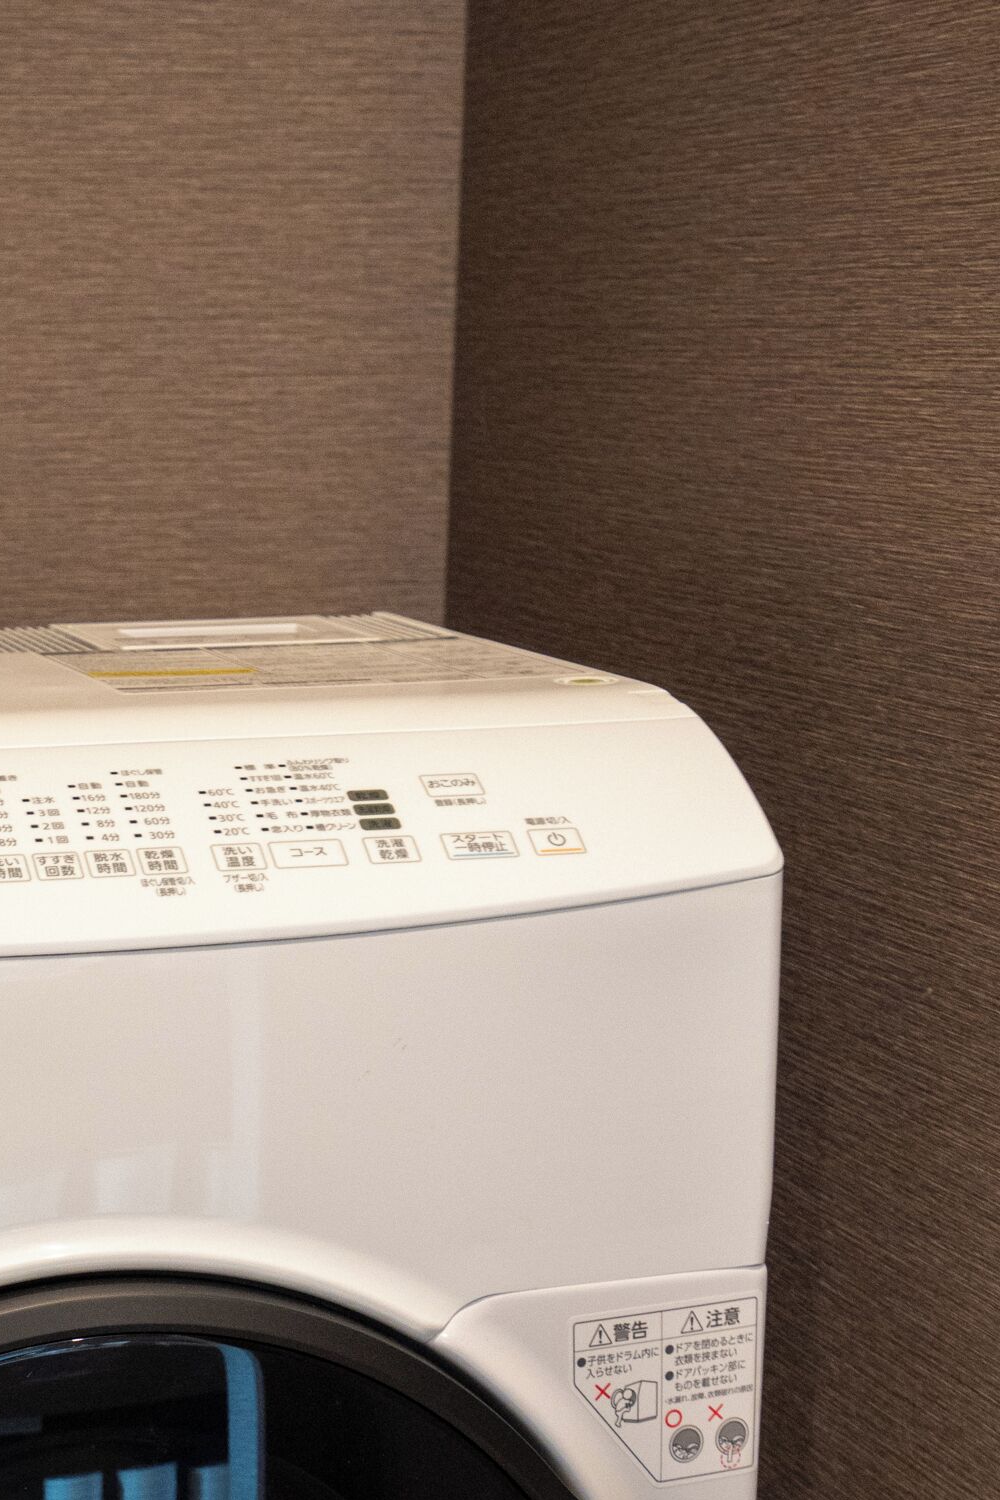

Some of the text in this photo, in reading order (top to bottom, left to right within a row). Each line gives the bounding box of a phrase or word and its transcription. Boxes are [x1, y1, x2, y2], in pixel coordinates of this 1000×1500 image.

[78, 782, 102, 790] 自動
[126, 780, 149, 788] 自動
[428, 778, 476, 788] おこのみ
[32, 796, 55, 804] 注水
[82, 794, 106, 802] 16分
[129, 792, 160, 800] 180分
[86, 806, 111, 815] 12分
[134, 804, 166, 812] 120分
[96, 819, 115, 828] 8分
[144, 817, 170, 826] 60分
[102, 833, 120, 842] 4分
[150, 831, 175, 840] 30分
[451, 833, 504, 844] スタート
[376, 839, 404, 848] 洗濯
[454, 842, 508, 852] 一時停止
[144, 850, 174, 860] 乾燥
[223, 847, 252, 856] 洗い
[288, 846, 327, 857] コース
[378, 848, 408, 860] 乾燥
[38, 855, 75, 865] すすぎ
[94, 852, 124, 863] 脱水
[226, 856, 256, 867] 温度
[45, 865, 76, 877] 回数
[96, 862, 128, 874] 時間
[148, 860, 179, 872] 時間
[706, 1307, 740, 1328] 注意
[614, 1321, 648, 1342] 警告
[675, 1333, 753, 1354] ドアを閉めるときに
[586, 1347, 660, 1366] 子供をドラム内に
[674, 1348, 738, 1367] 衣類を挟まない
[586, 1364, 632, 1380] 入らせない
[675, 1360, 746, 1380] ドアパッキン部に
[675, 1374, 738, 1392] ものを載せない
